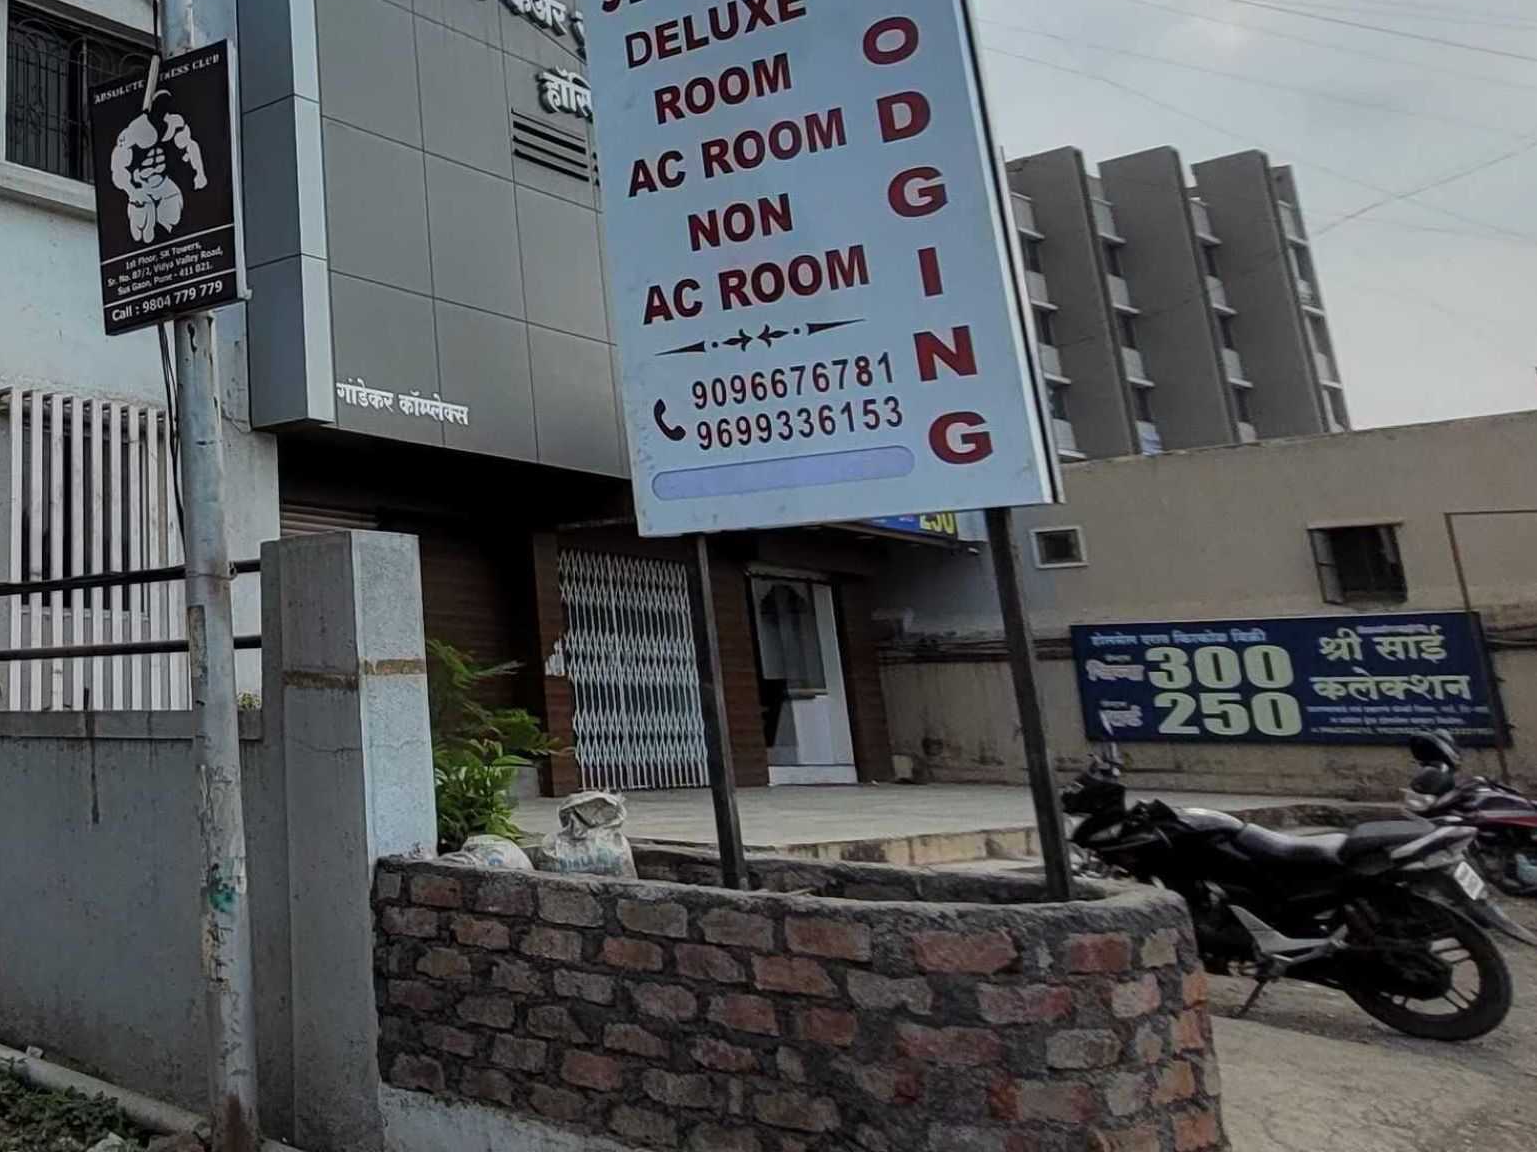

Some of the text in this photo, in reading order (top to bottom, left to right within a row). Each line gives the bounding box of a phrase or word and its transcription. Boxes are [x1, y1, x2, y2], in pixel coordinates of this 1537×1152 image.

[93, 79, 145, 105] ABSOLUTE
[191, 53, 220, 70] CLUB
[653, 53, 792, 125] ROOM
[627, 107, 847, 198] AC ROOM
[686, 193, 794, 252] NON
[112, 304, 134, 322] Call
[142, 294, 172, 314] 9804
[173, 287, 197, 305] 779
[199, 279, 224, 298] 779
[642, 244, 871, 326] AC ROOM
[691, 351, 896, 411] 9096676781
[696, 395, 904, 451] 9699336153
[1144, 645, 1295, 689] 300
[1318, 624, 1448, 663] श्री साई
[1308, 666, 1472, 701] कलेक्शन
[1153, 691, 1303, 736] 250
